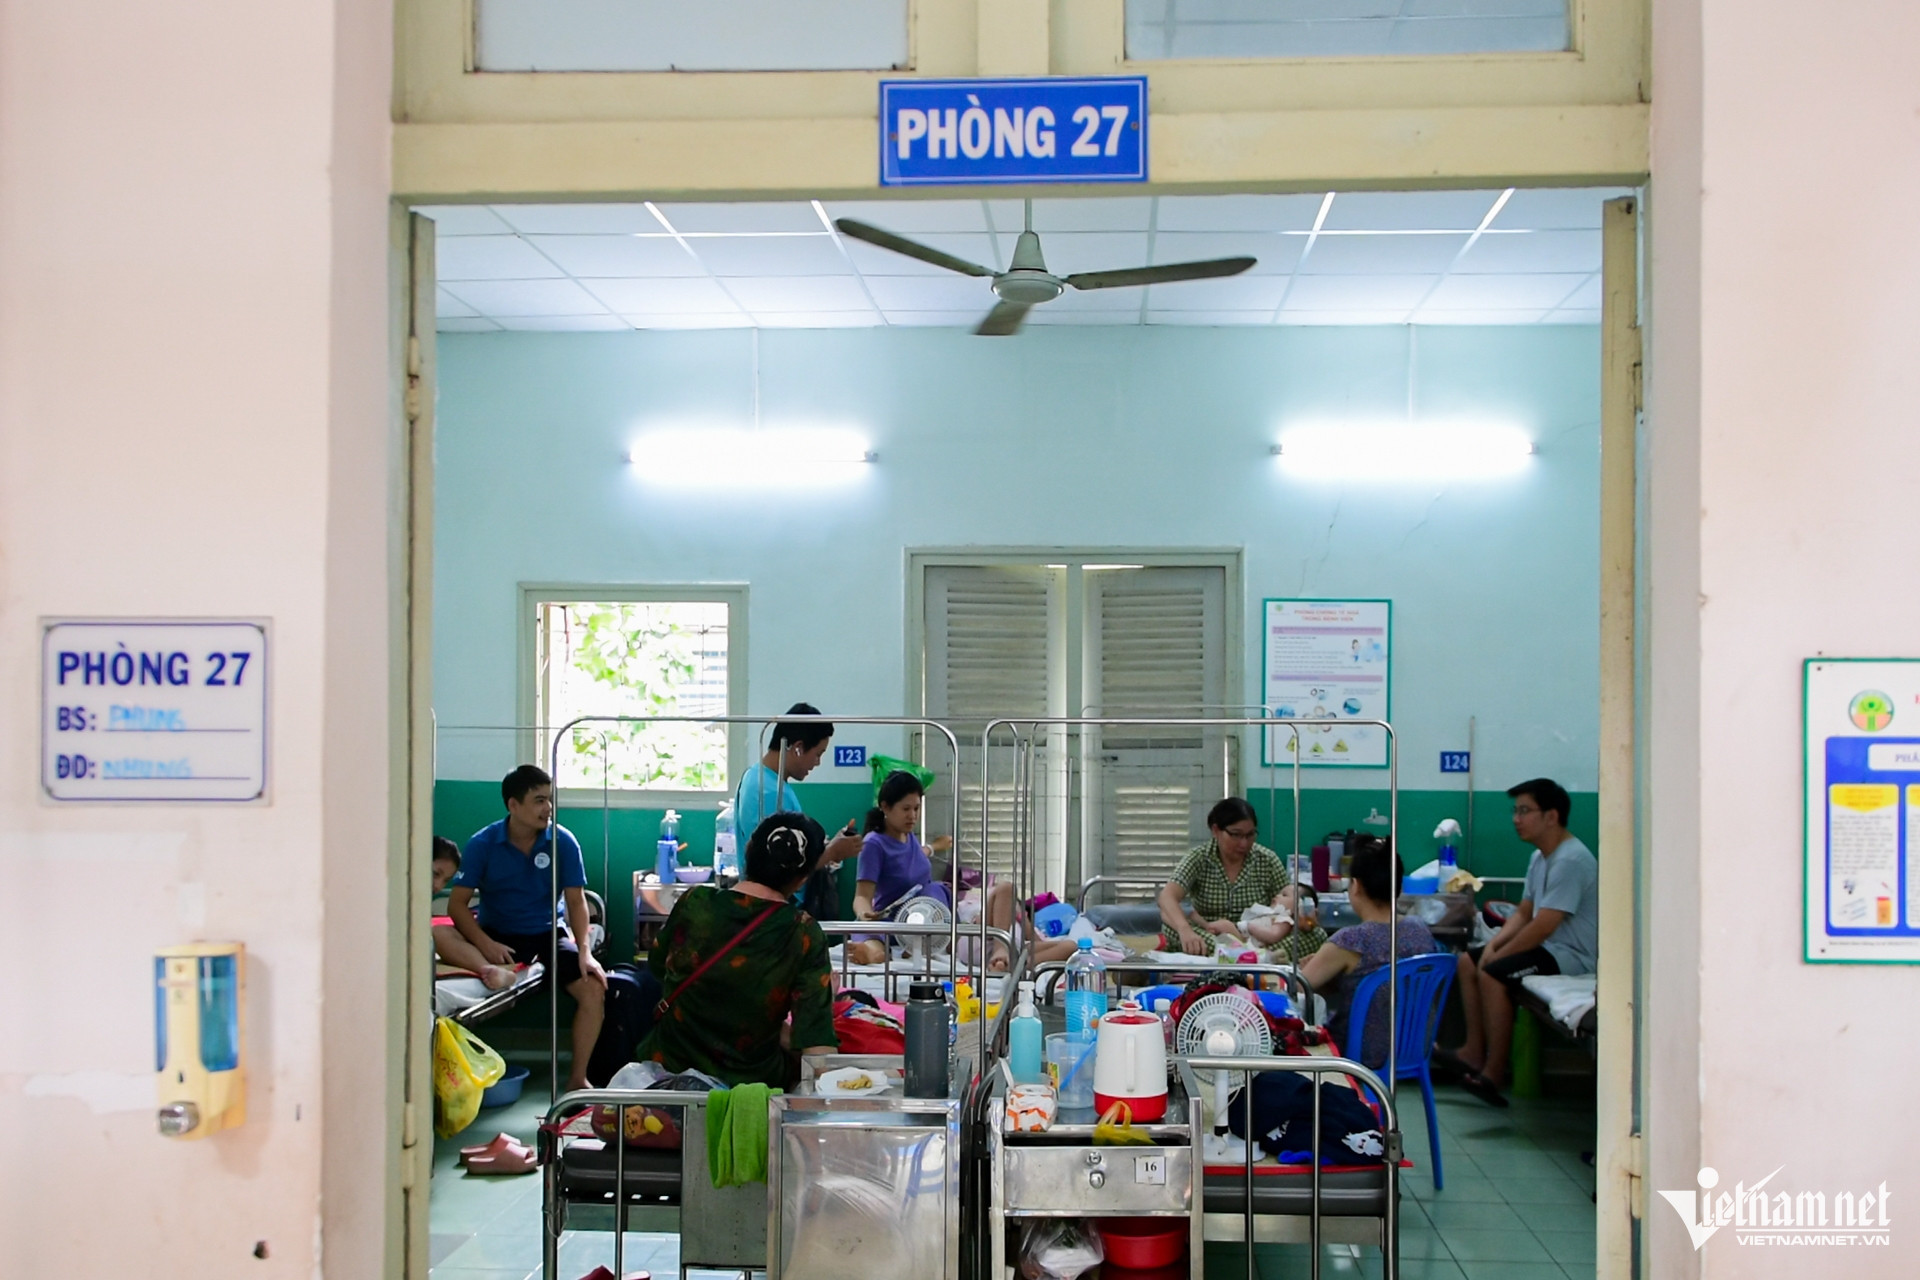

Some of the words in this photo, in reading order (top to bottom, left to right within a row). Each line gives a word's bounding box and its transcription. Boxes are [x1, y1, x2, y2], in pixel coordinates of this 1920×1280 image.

[897, 93, 1056, 160] PHÒNG
[1070, 105, 1130, 158] 27
[57, 641, 190, 686] PHÒNG
[204, 651, 252, 686] 27
[56, 705, 97, 732] BS:
[56, 753, 97, 780] ĐD:
[838, 749, 862, 764] 123
[1444, 754, 1469, 770] 124
[1145, 1161, 1157, 1172] 16
